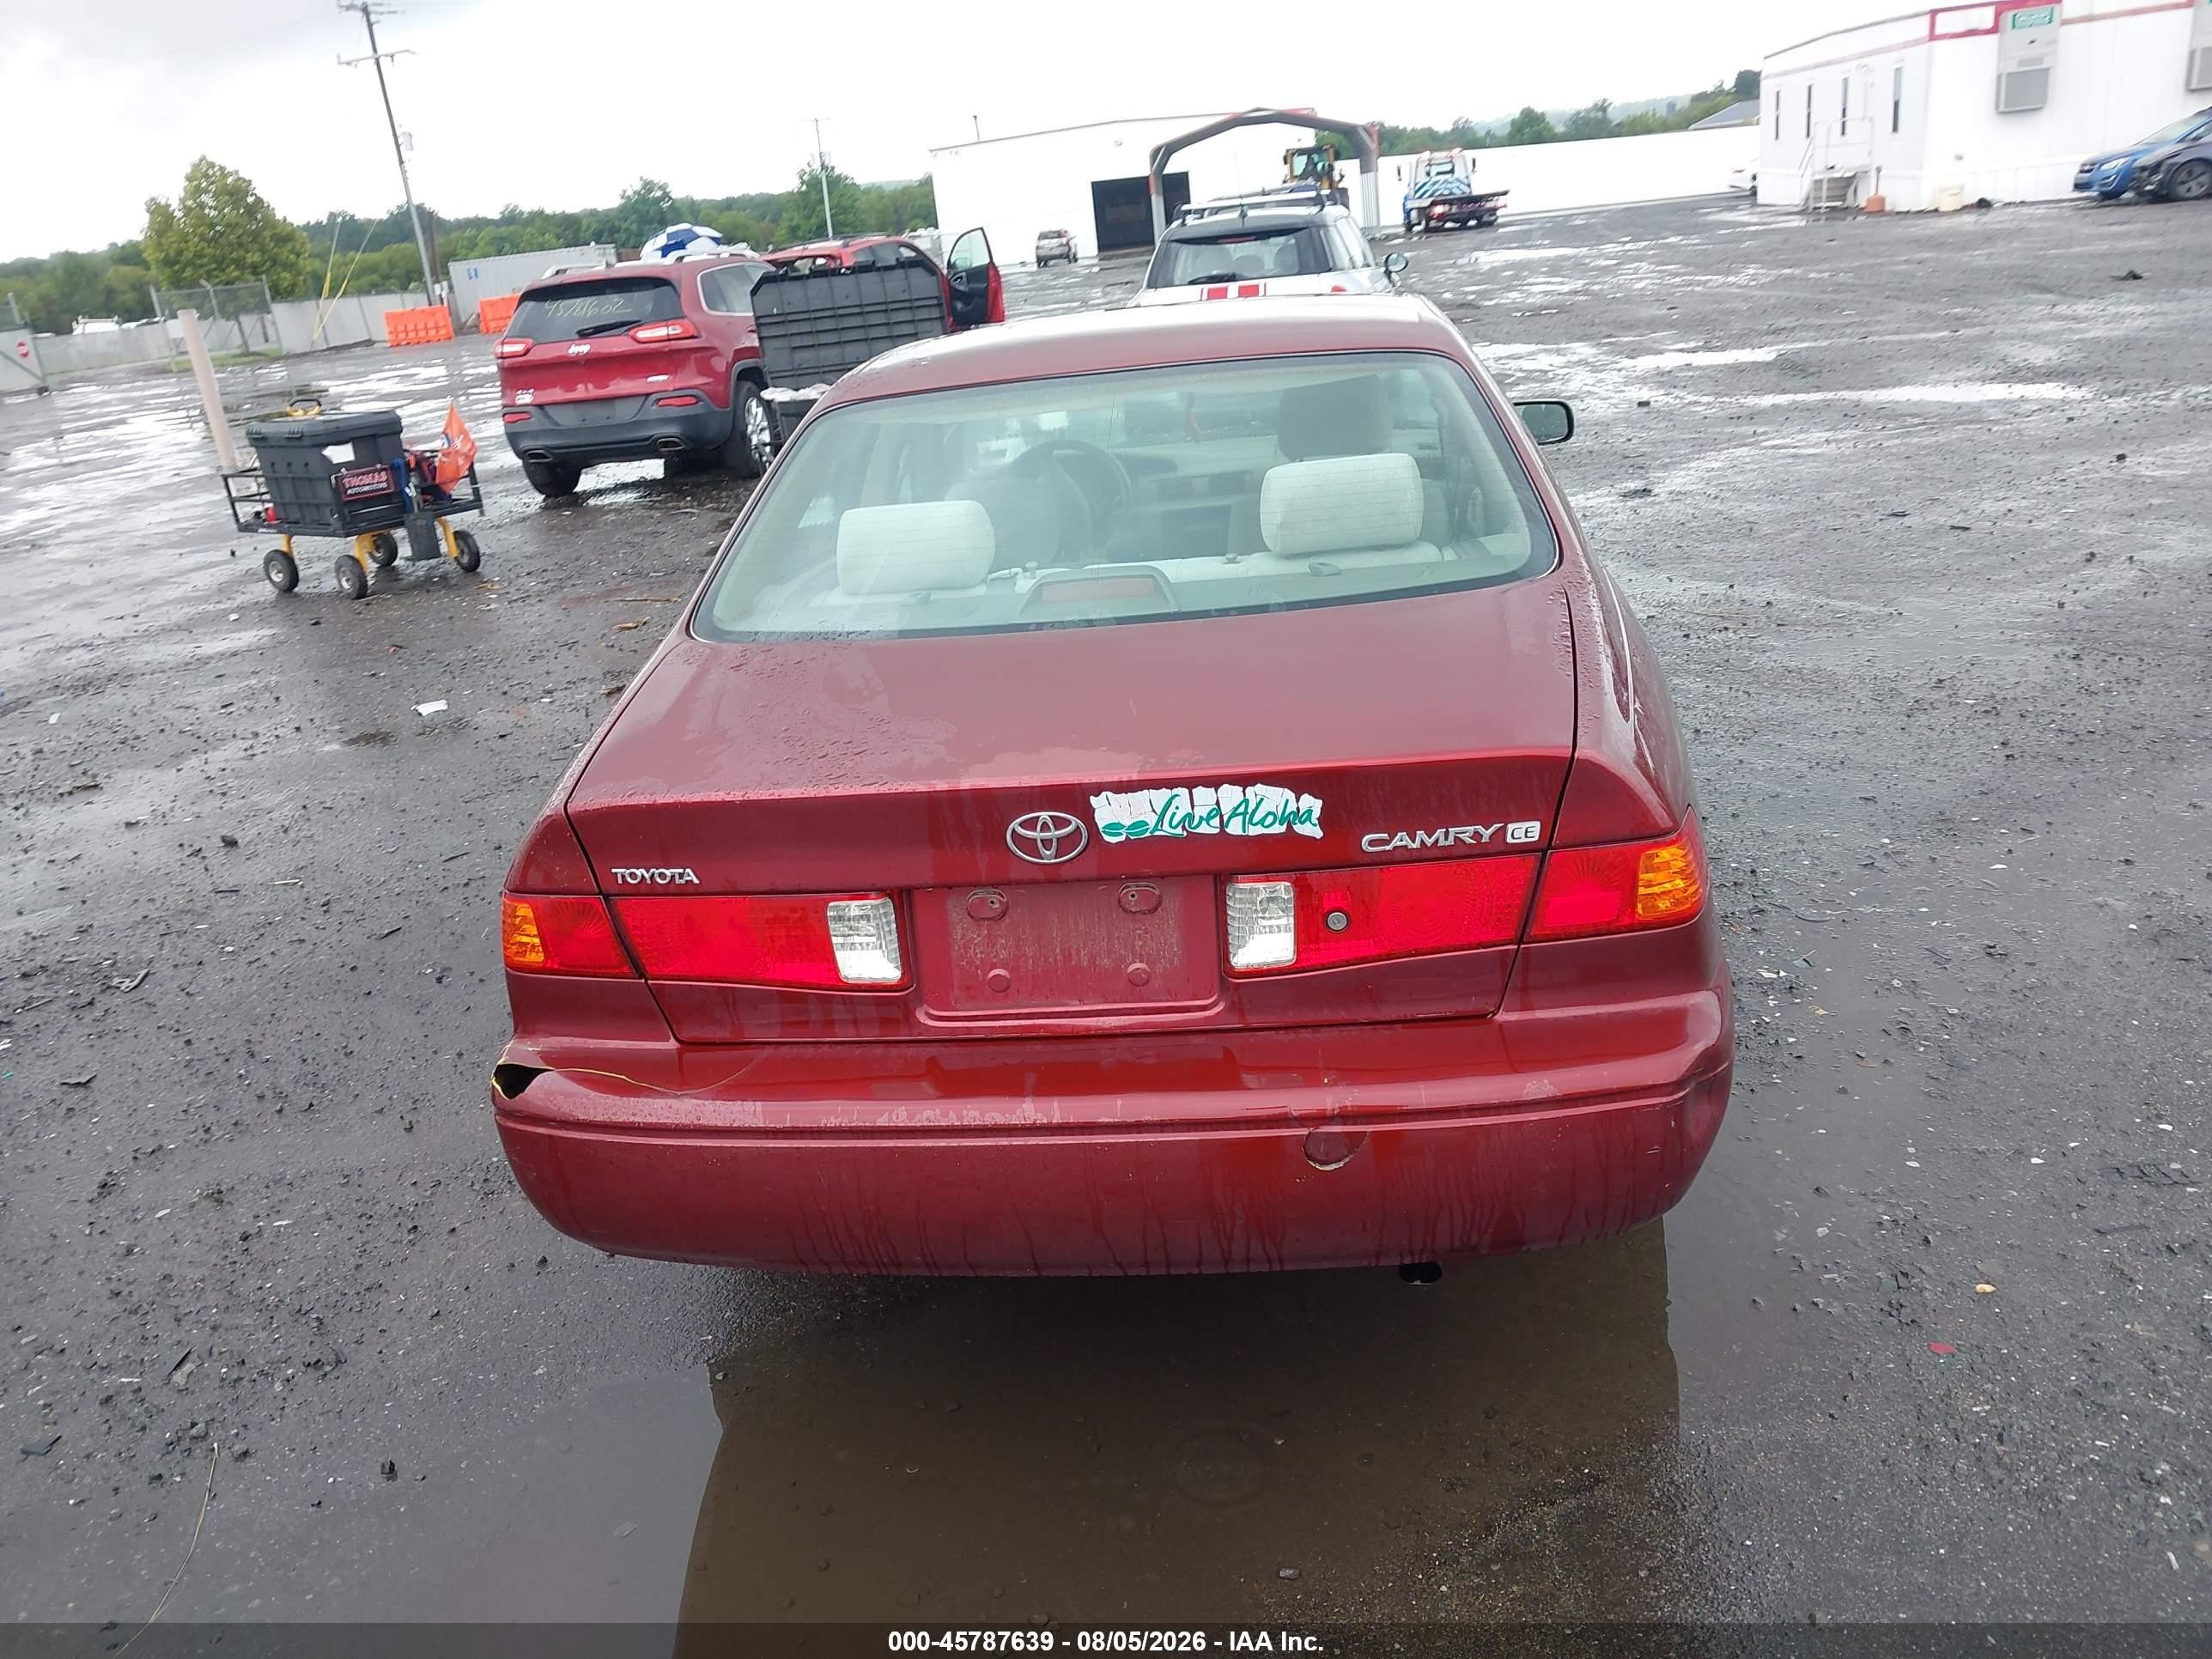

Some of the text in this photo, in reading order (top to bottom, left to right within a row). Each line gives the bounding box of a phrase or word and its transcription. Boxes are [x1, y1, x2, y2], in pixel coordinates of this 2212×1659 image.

[1149, 793, 1318, 837] Live Aloha
[1361, 823, 1536, 853] CAMRY CE
[611, 868, 701, 884] TOYOTA
